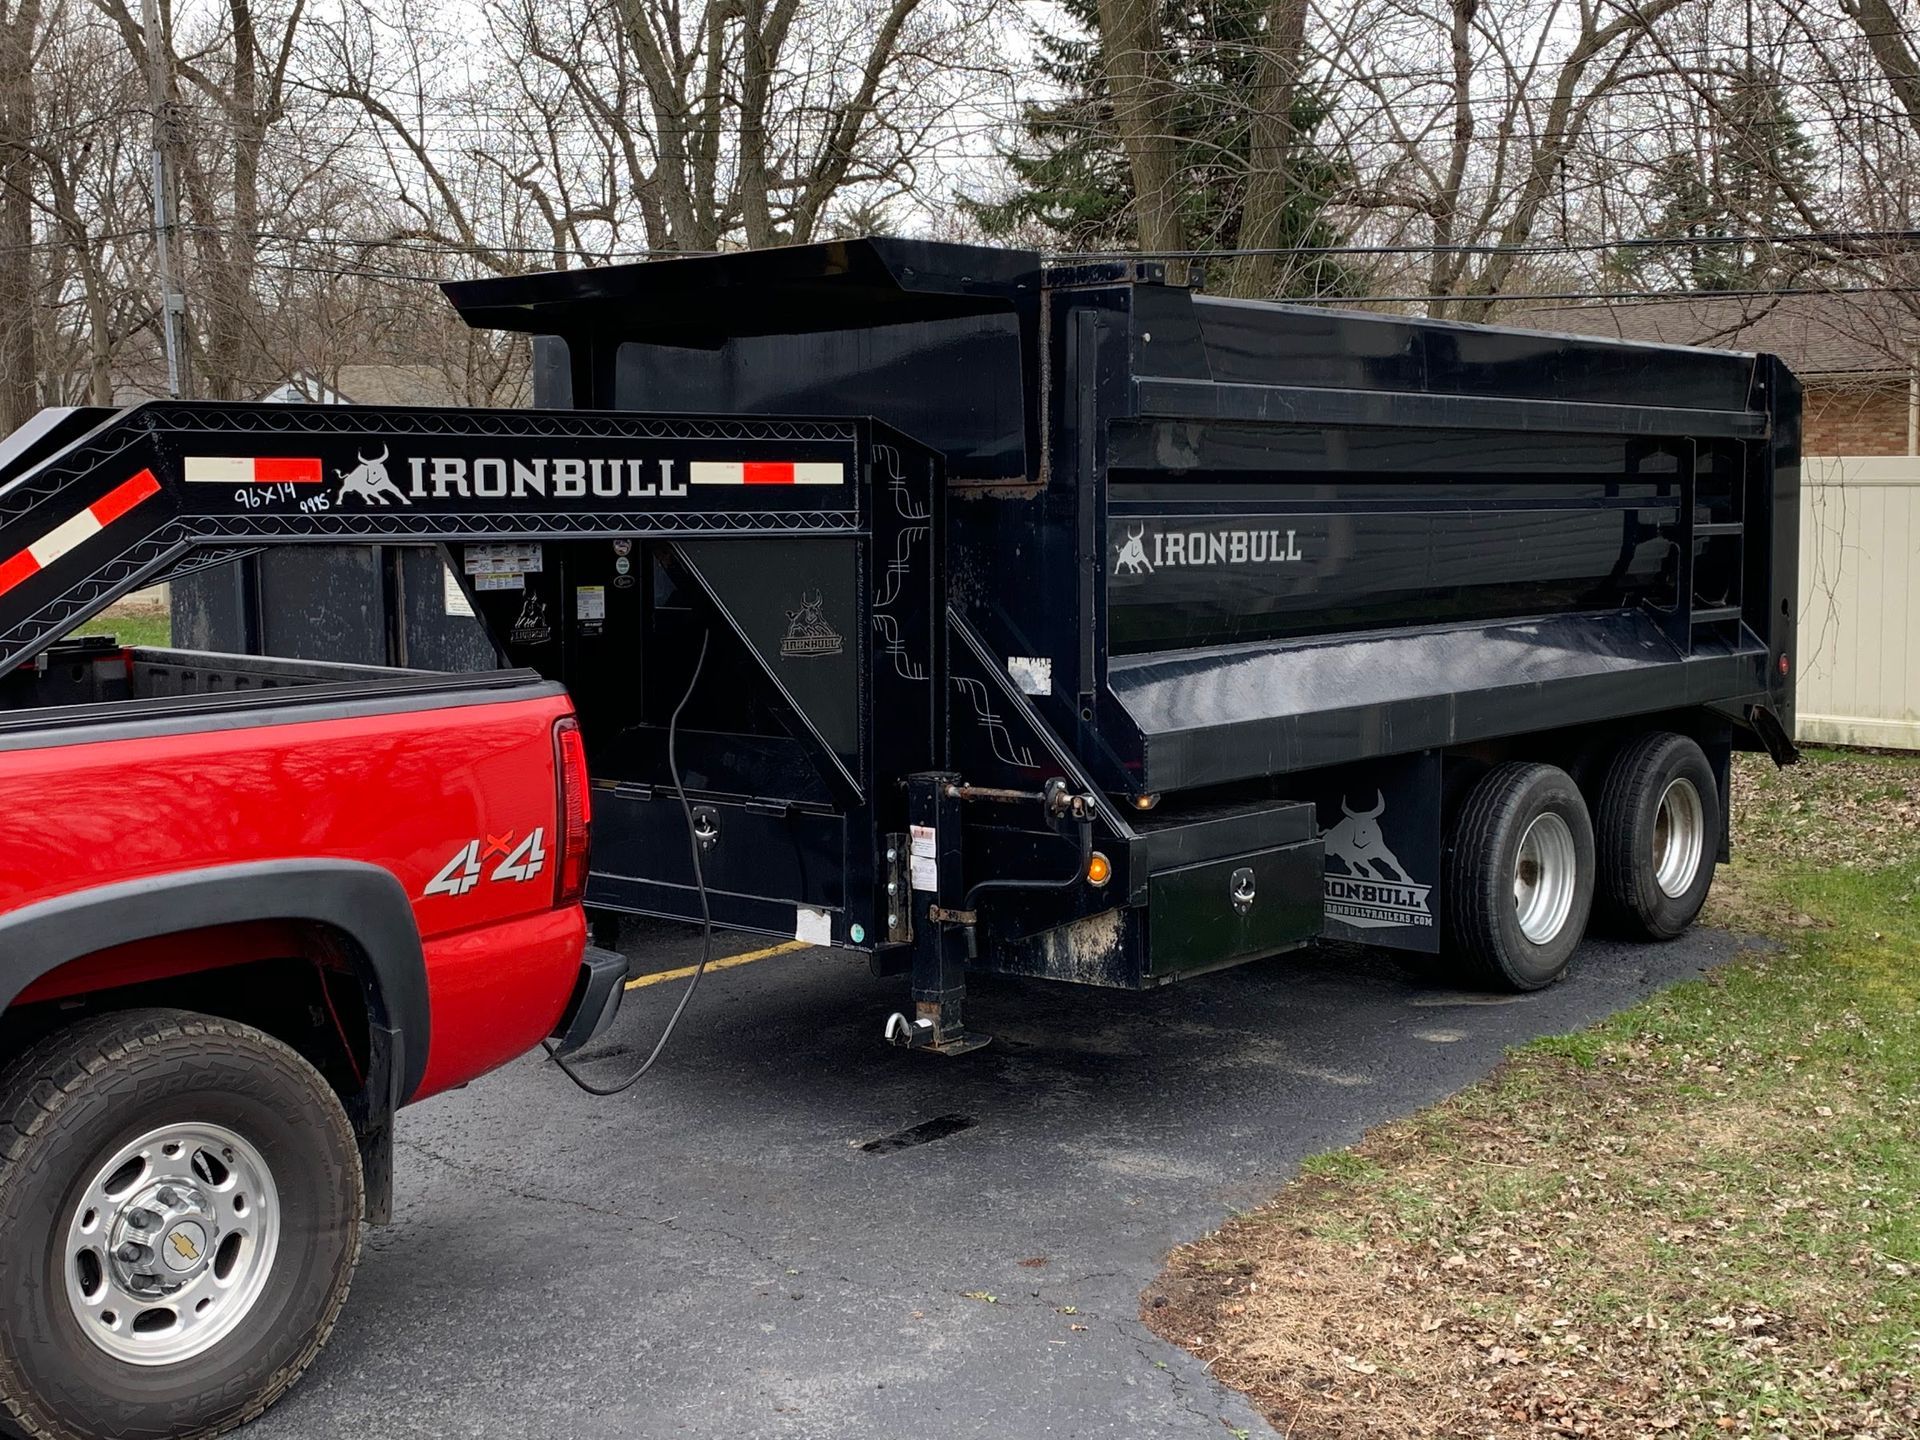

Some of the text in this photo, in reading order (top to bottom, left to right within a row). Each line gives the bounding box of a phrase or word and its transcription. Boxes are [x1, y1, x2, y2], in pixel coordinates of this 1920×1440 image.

[408, 457, 688, 497] IRONBULL
[1153, 530, 1302, 567] IRONBULL
[1324, 880, 1422, 909] RONBULL
